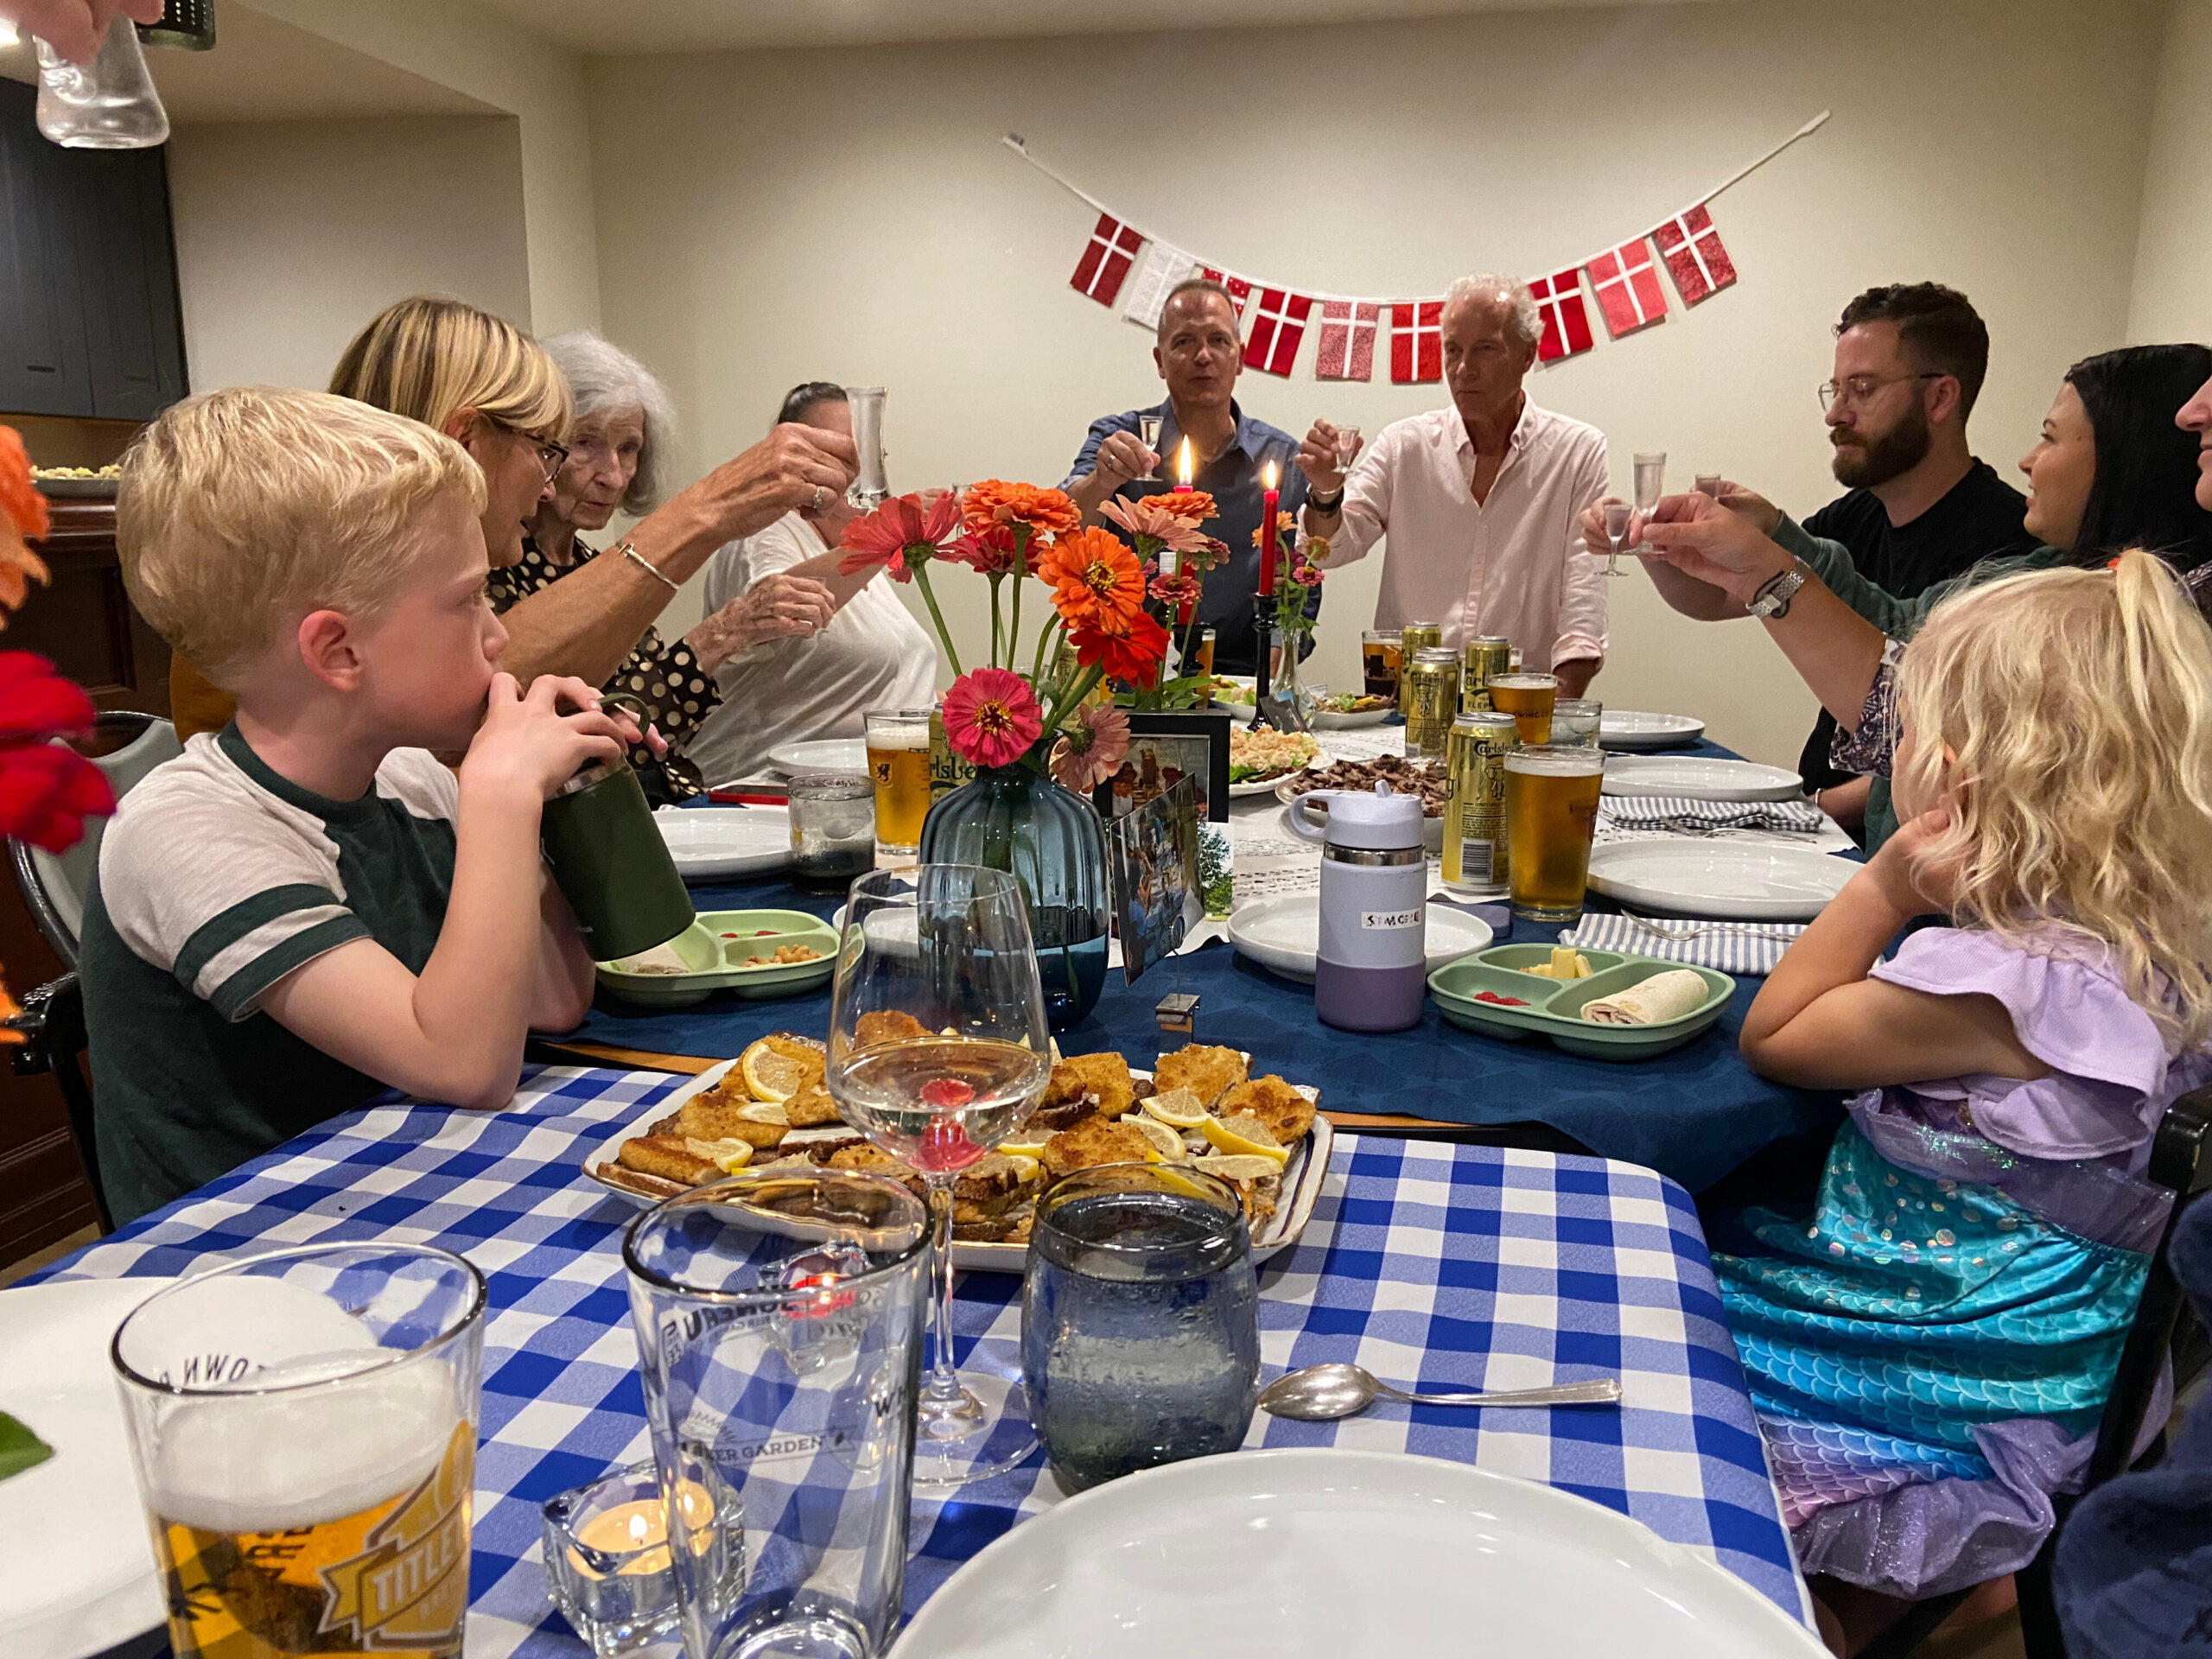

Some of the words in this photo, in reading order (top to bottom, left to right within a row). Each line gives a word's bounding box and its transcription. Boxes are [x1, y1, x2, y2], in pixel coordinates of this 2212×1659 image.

[1474, 741, 1505, 756] Carls
[929, 755, 976, 780] rlsbe
[742, 1434, 826, 1459] GARDEN
